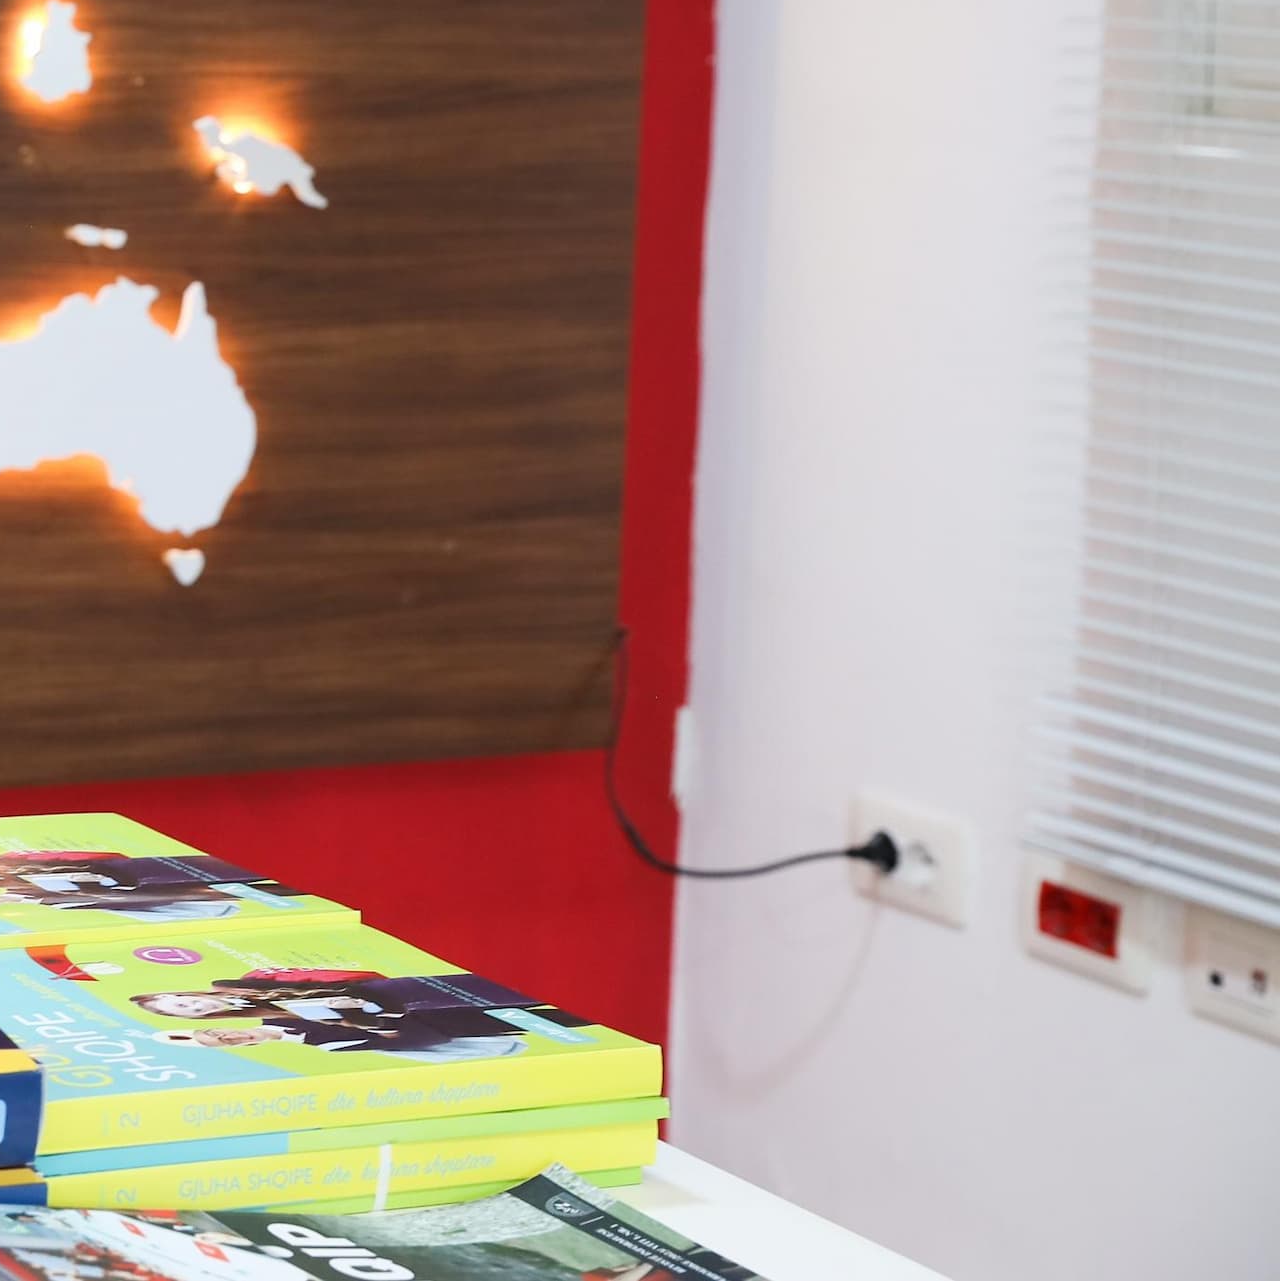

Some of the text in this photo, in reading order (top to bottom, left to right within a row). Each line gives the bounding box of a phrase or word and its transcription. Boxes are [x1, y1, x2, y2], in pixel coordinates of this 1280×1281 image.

[12, 1011, 197, 1083] SHQIPE
[182, 1098, 248, 1128] GJUHA
[250, 1094, 318, 1120] SHQIPE
[178, 1169, 242, 1200] GJUHA
[247, 1166, 313, 1192] SHQIPE
